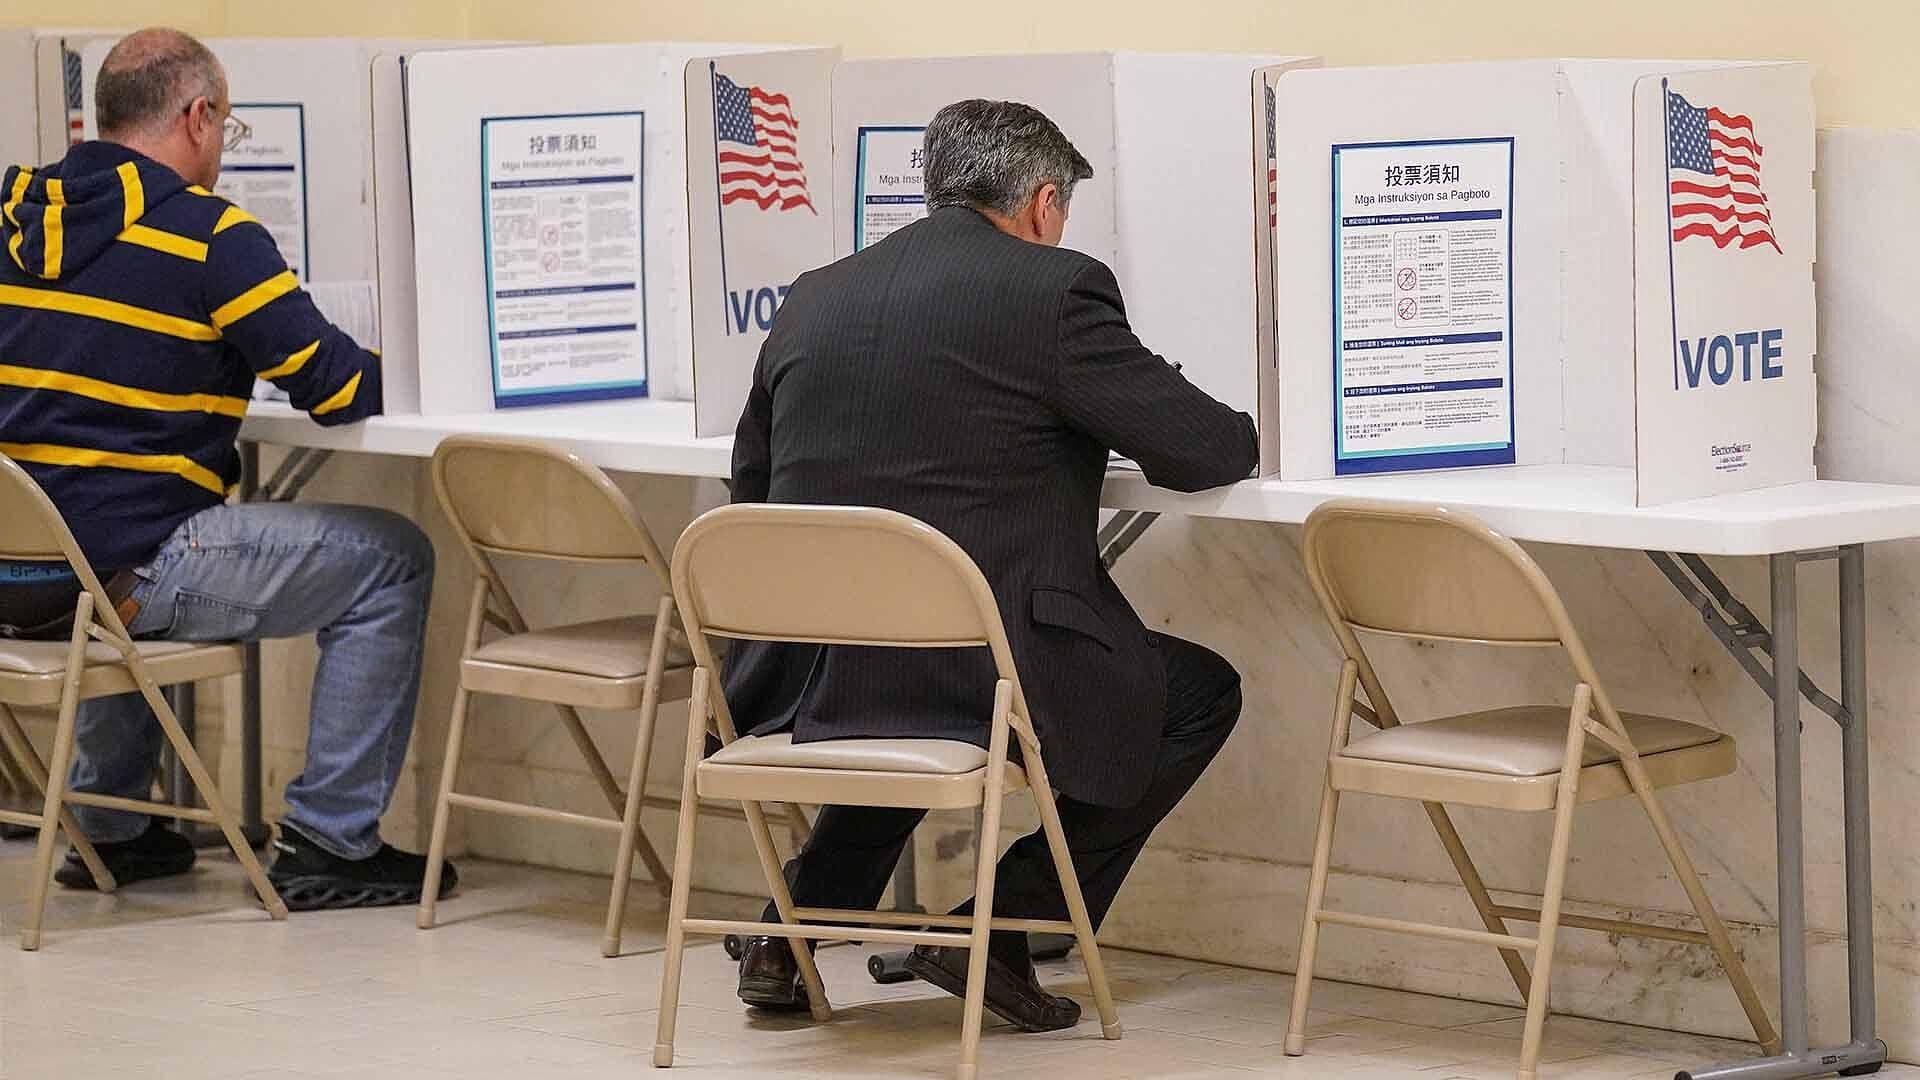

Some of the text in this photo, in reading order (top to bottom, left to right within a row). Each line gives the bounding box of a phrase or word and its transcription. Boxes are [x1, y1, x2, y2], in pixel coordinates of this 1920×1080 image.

[879, 175, 900, 186] Mga
[1385, 163, 1460, 187] 投票須知
[1354, 188, 1491, 206] Mga Instruksiyon sa Pagboto
[1680, 329, 1783, 388] VOTE
